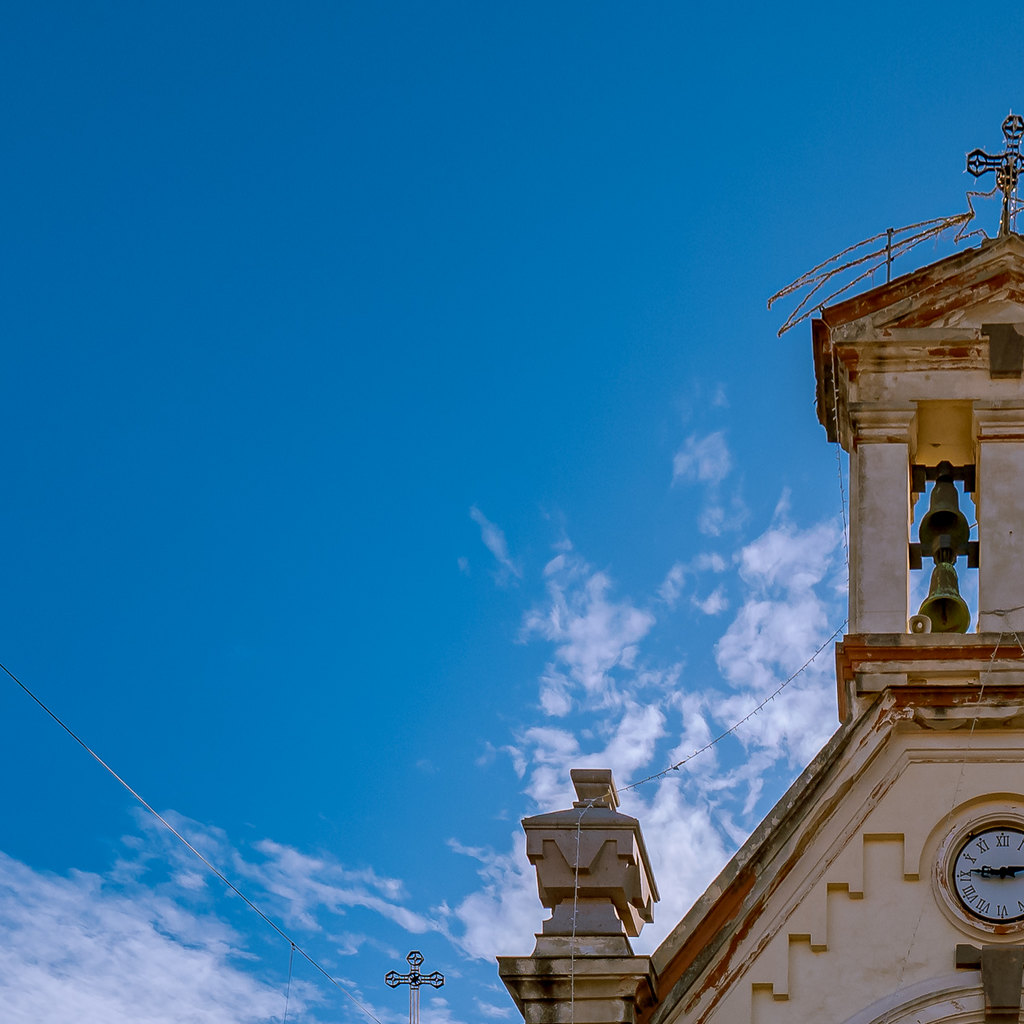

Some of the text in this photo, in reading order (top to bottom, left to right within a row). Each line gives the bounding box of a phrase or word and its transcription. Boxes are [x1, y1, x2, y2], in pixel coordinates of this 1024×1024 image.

[976, 840, 990, 853] XI
[996, 836, 1009, 847] XII
[965, 854, 976, 864] X
[960, 871, 971, 881] IX
[962, 885, 978, 903] VIII
[976, 899, 990, 913] VII
[997, 905, 1008, 916] VI
